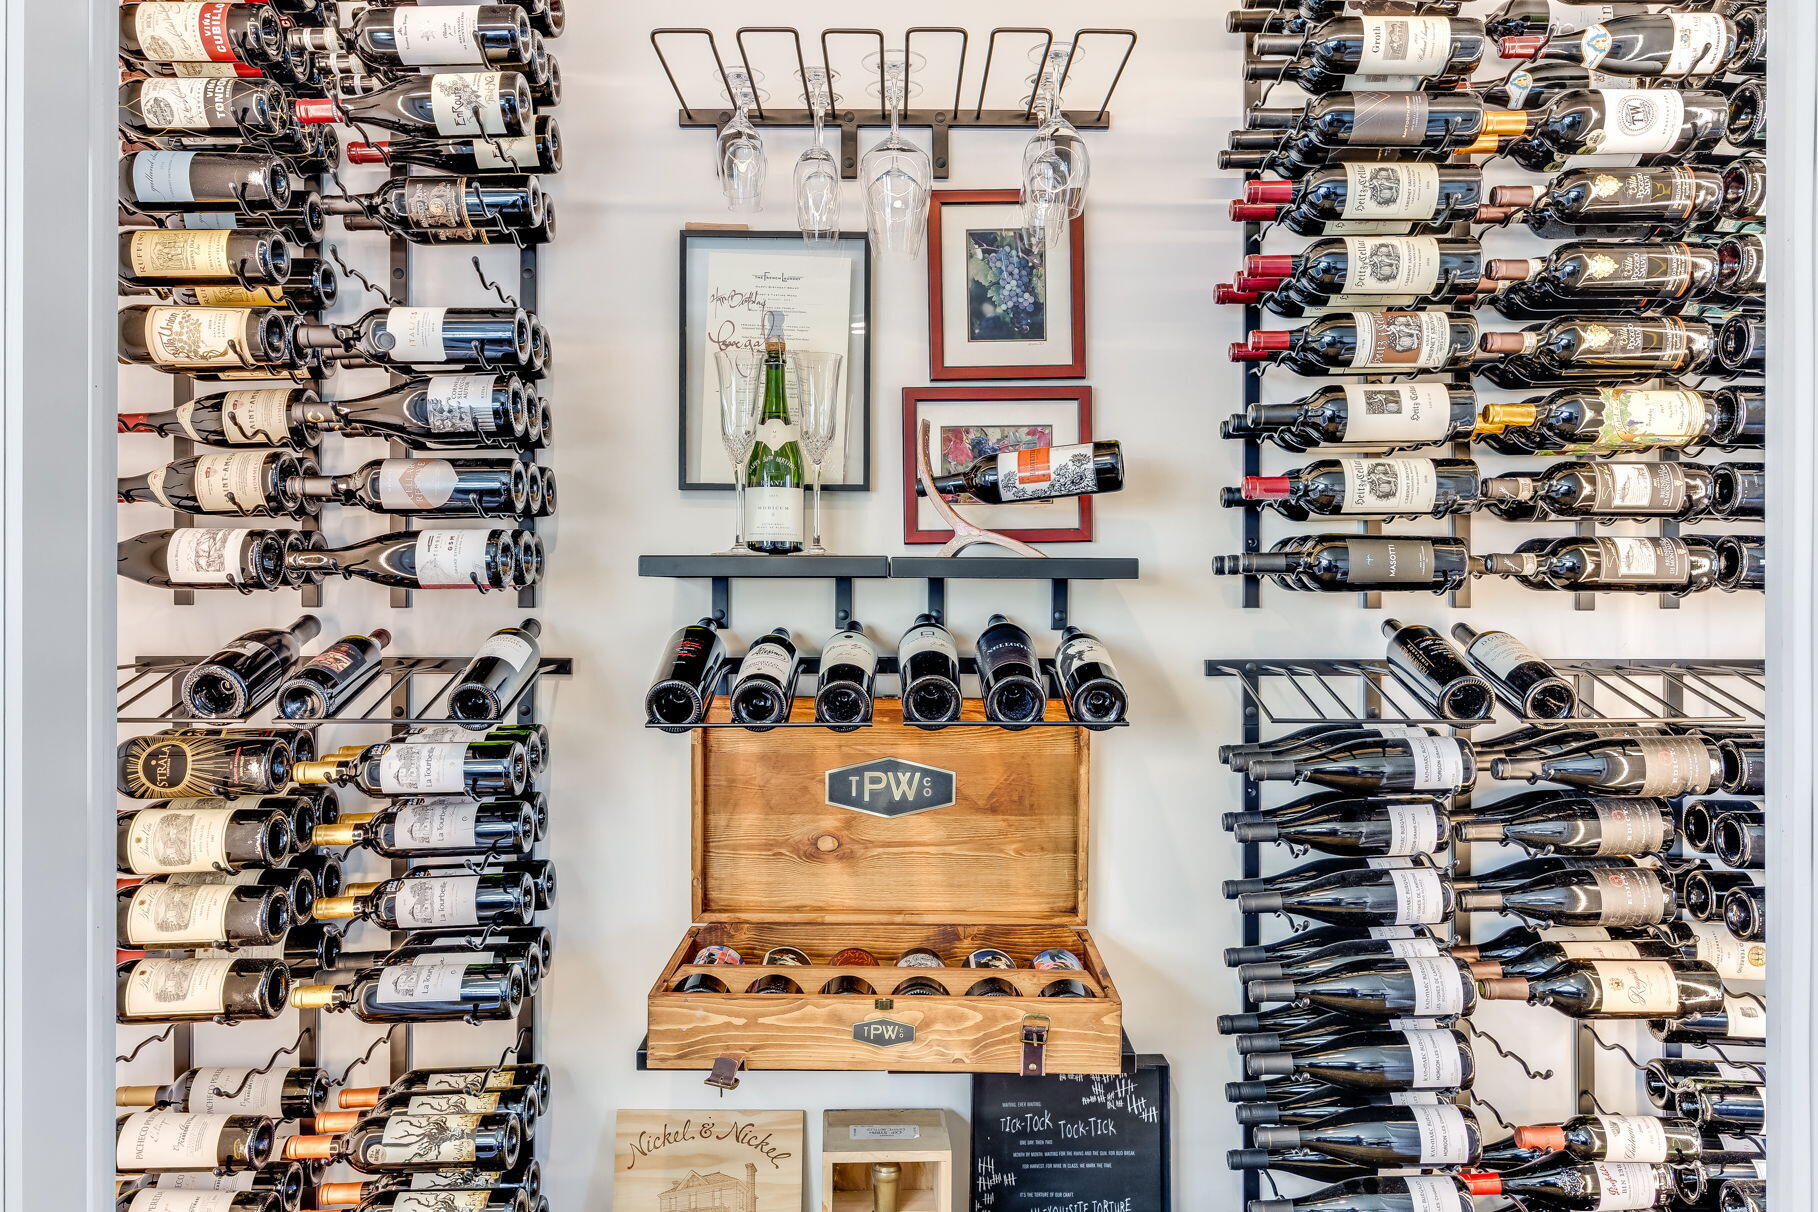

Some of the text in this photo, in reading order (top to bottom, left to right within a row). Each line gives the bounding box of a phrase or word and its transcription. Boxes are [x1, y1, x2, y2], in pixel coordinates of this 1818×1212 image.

[202, 12, 212, 37] VIÑA
[211, 3, 227, 53] CUBILLO
[1371, 26, 1381, 54] Groth
[451, 86, 467, 127] EnRoute
[1354, 164, 1367, 212] Heitz Cellar
[1635, 172, 1644, 199] POGGIO
[1643, 174, 1651, 196] SALVI
[136, 231, 147, 273] RUFFINO
[1354, 240, 1369, 288] Heitz Cellar
[1630, 253, 1640, 280] POGGIO
[1638, 256, 1647, 277] SALVI
[1372, 340, 1386, 363] Heitz
[1626, 323, 1635, 350] POGGIO
[1410, 402, 1421, 421] Heitz
[1354, 460, 1366, 506] Heitz Cellar
[1388, 544, 1397, 577] MASOTTI
[424, 746, 435, 788] La Tourbelle
[437, 832, 445, 842] La
[437, 881, 448, 922] La Tourbelle
[421, 984, 430, 994] La
[999, 1109, 1117, 1140] TICK-TOCK TOCK-TICK
[135, 1126, 150, 1160] PACHECO
[627, 1116, 792, 1170] Nickel & Nickel
[1599, 1164, 1620, 1196] Penfolds
[1620, 1180, 1628, 1194] BIN
